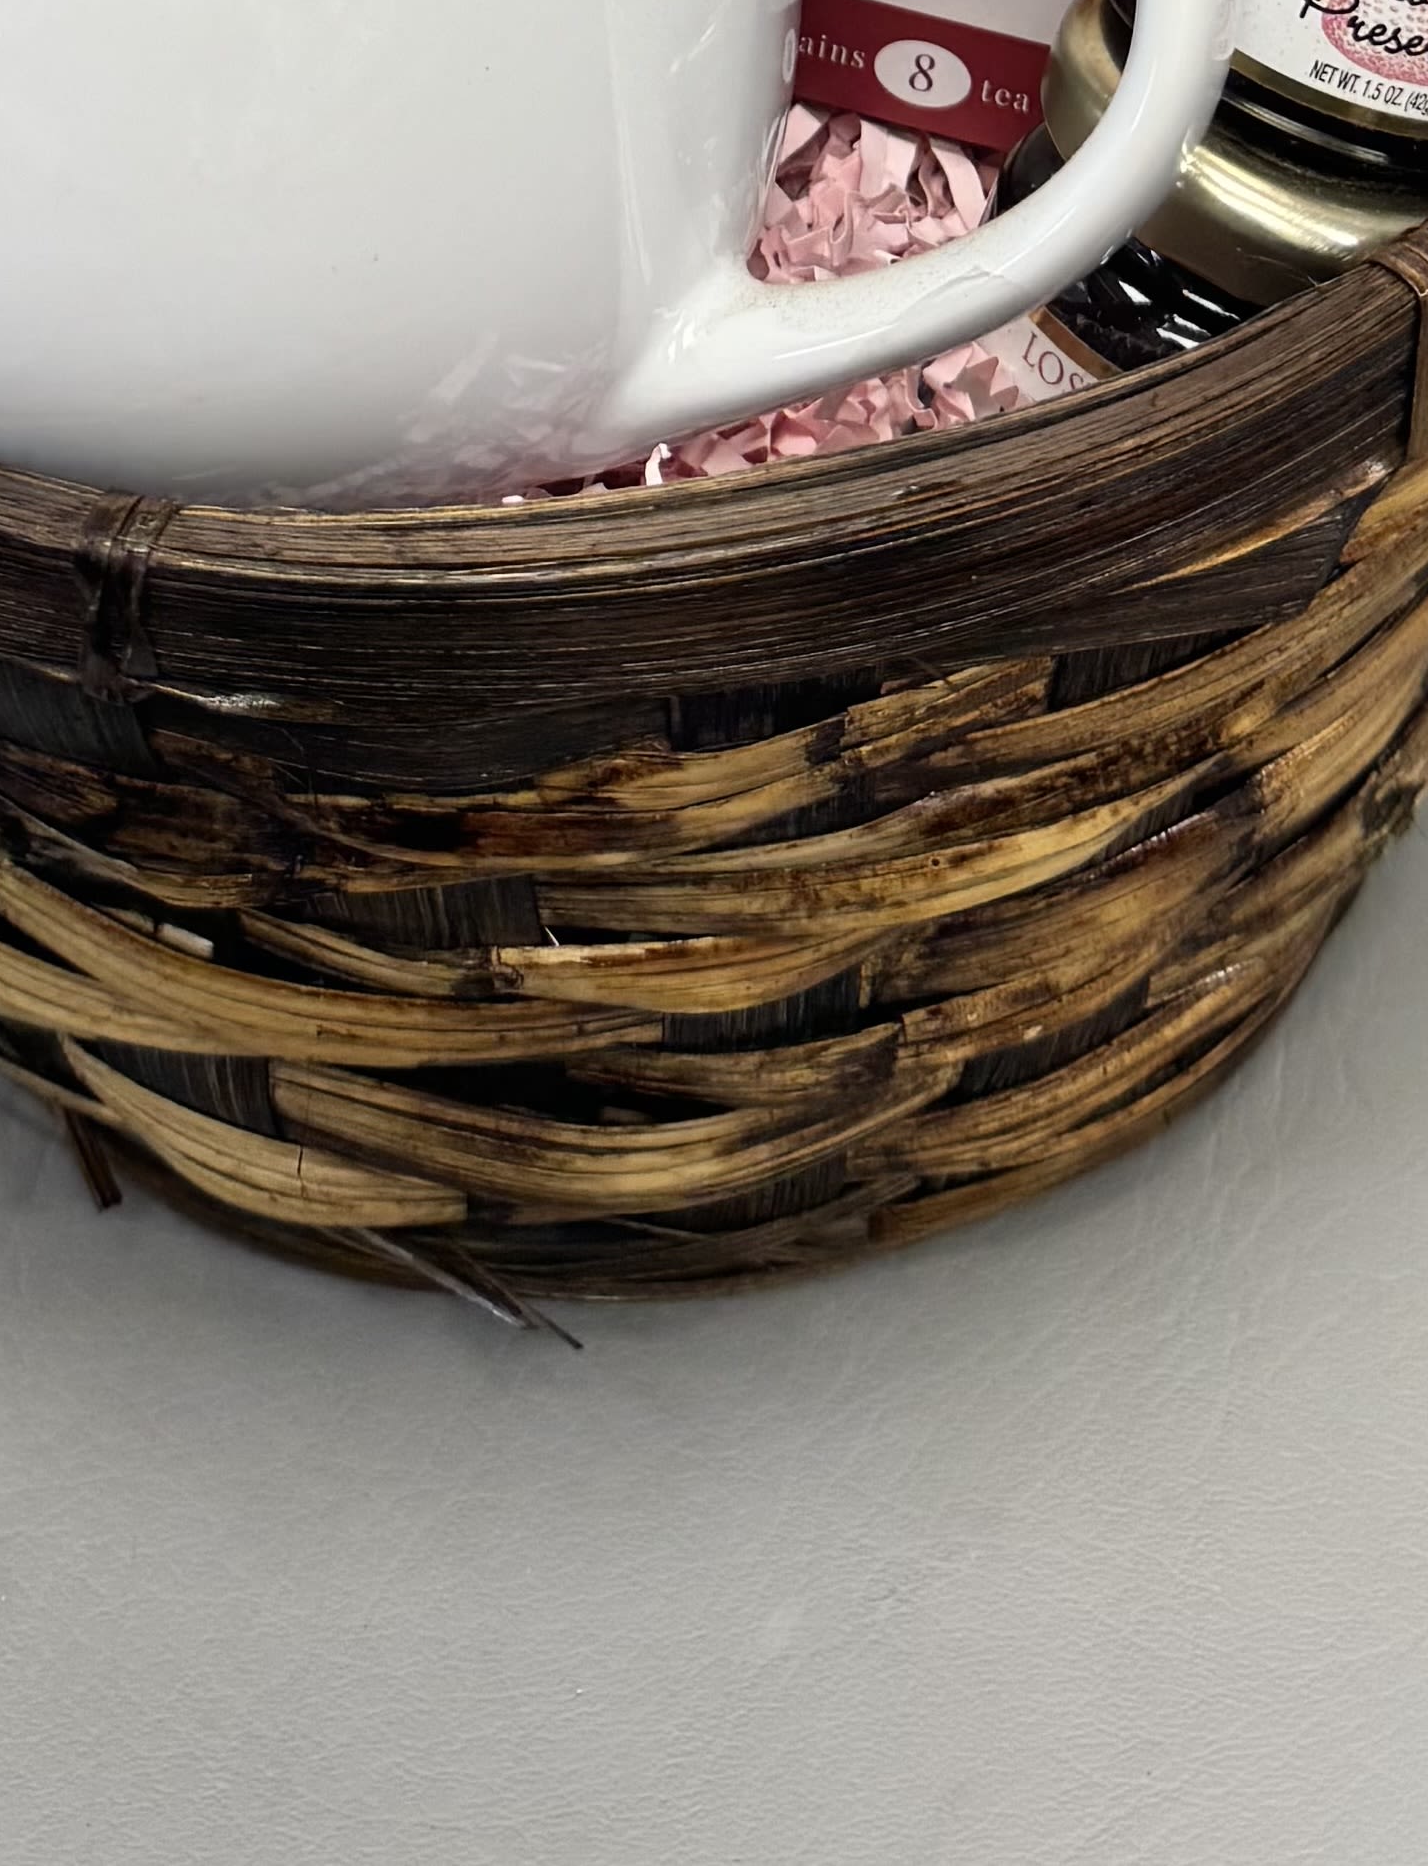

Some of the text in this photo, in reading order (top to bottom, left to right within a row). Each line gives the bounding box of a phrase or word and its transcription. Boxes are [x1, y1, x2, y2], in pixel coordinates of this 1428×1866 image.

[797, 33, 1031, 114] ains 8 tea
[1309, 59, 1339, 84] NET
[1337, 70, 1361, 94] WT.
[1362, 79, 1384, 101] 1.5
